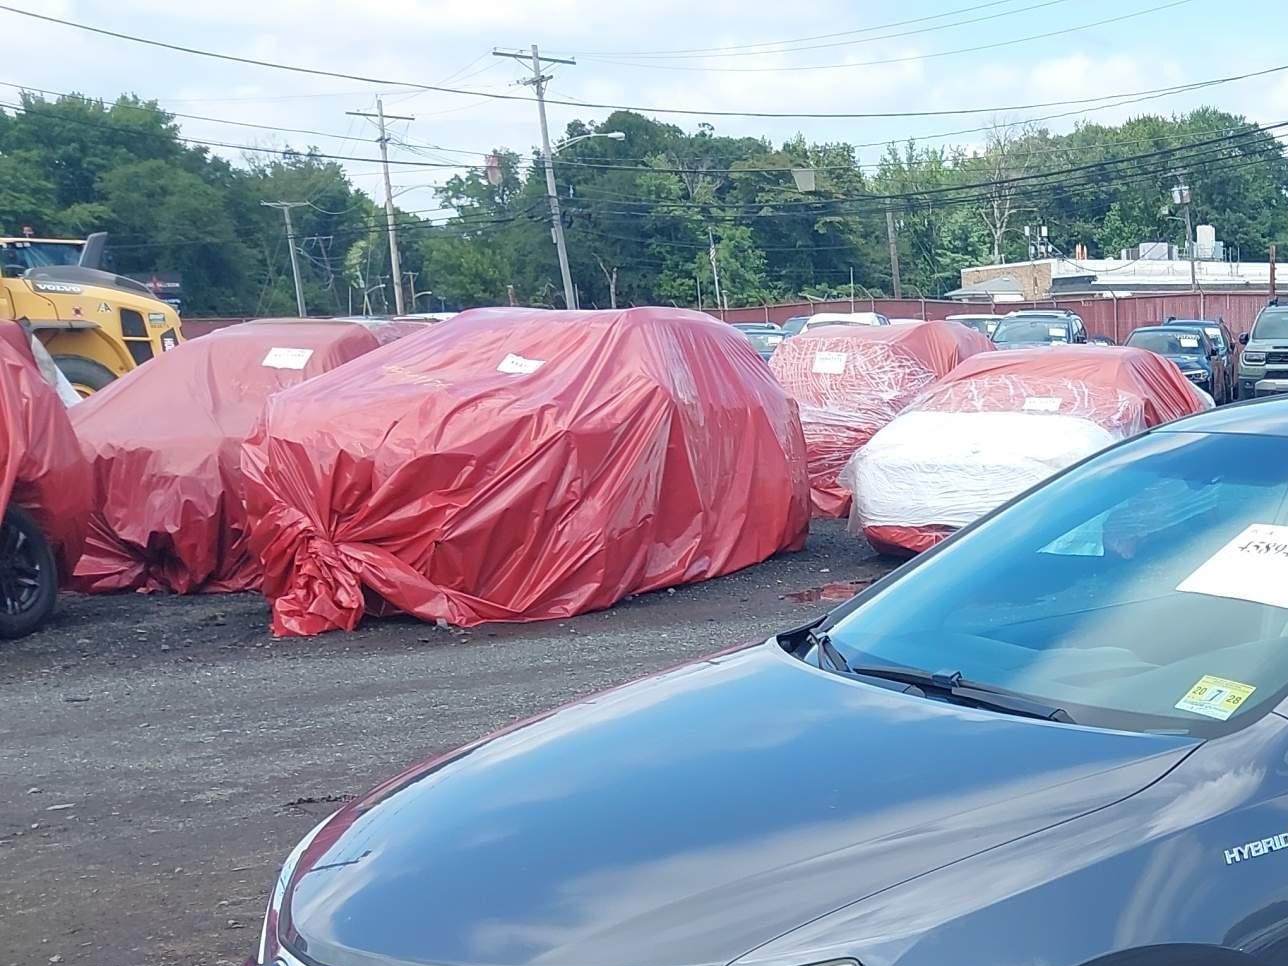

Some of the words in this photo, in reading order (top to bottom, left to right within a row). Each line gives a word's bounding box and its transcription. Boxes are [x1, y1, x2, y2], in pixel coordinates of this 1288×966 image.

[36, 283, 81, 292] VOLVO
[1192, 686, 1207, 696] 20
[1226, 694, 1242, 705] 28
